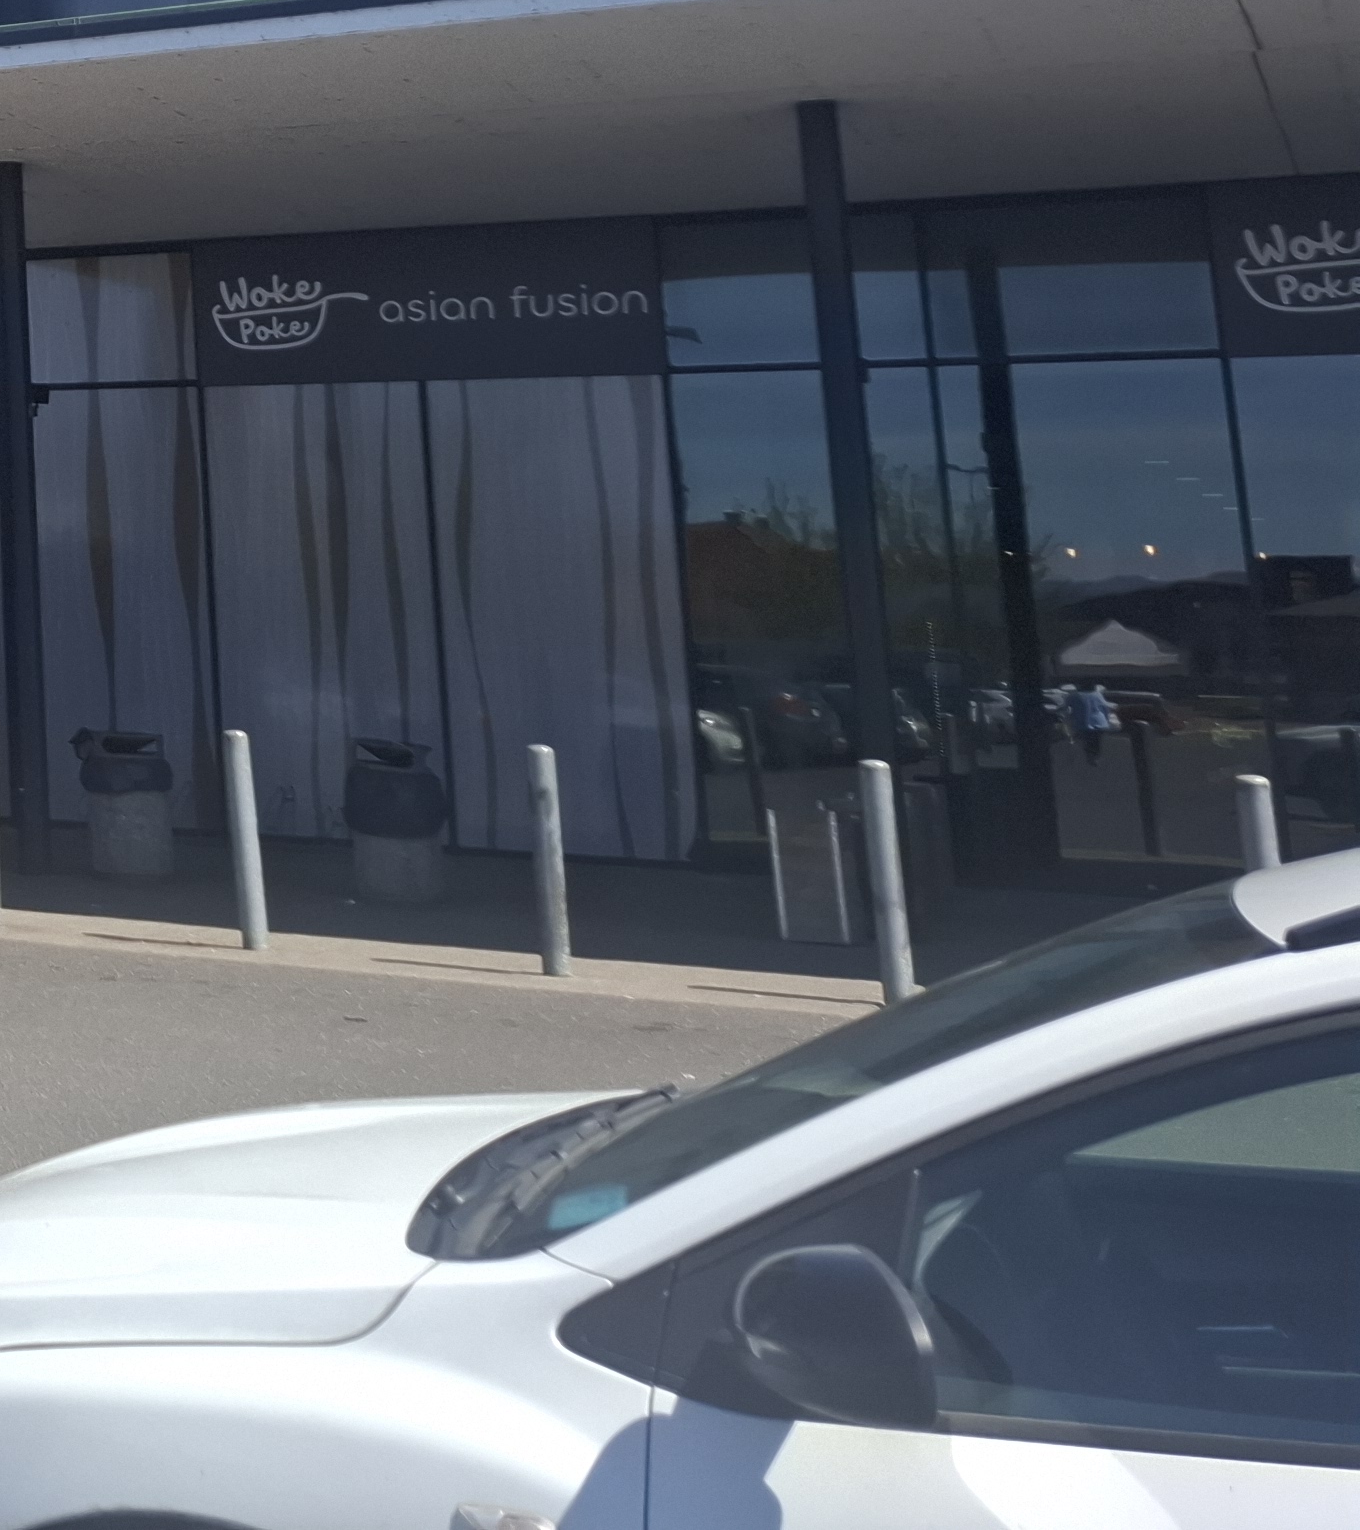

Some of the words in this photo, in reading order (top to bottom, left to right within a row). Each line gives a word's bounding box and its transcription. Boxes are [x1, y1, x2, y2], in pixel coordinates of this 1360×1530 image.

[1242, 219, 1360, 267] Wok
[219, 274, 322, 312] Woke
[379, 290, 495, 323] asian
[509, 284, 648, 319] fusion
[240, 315, 310, 344] Poke
